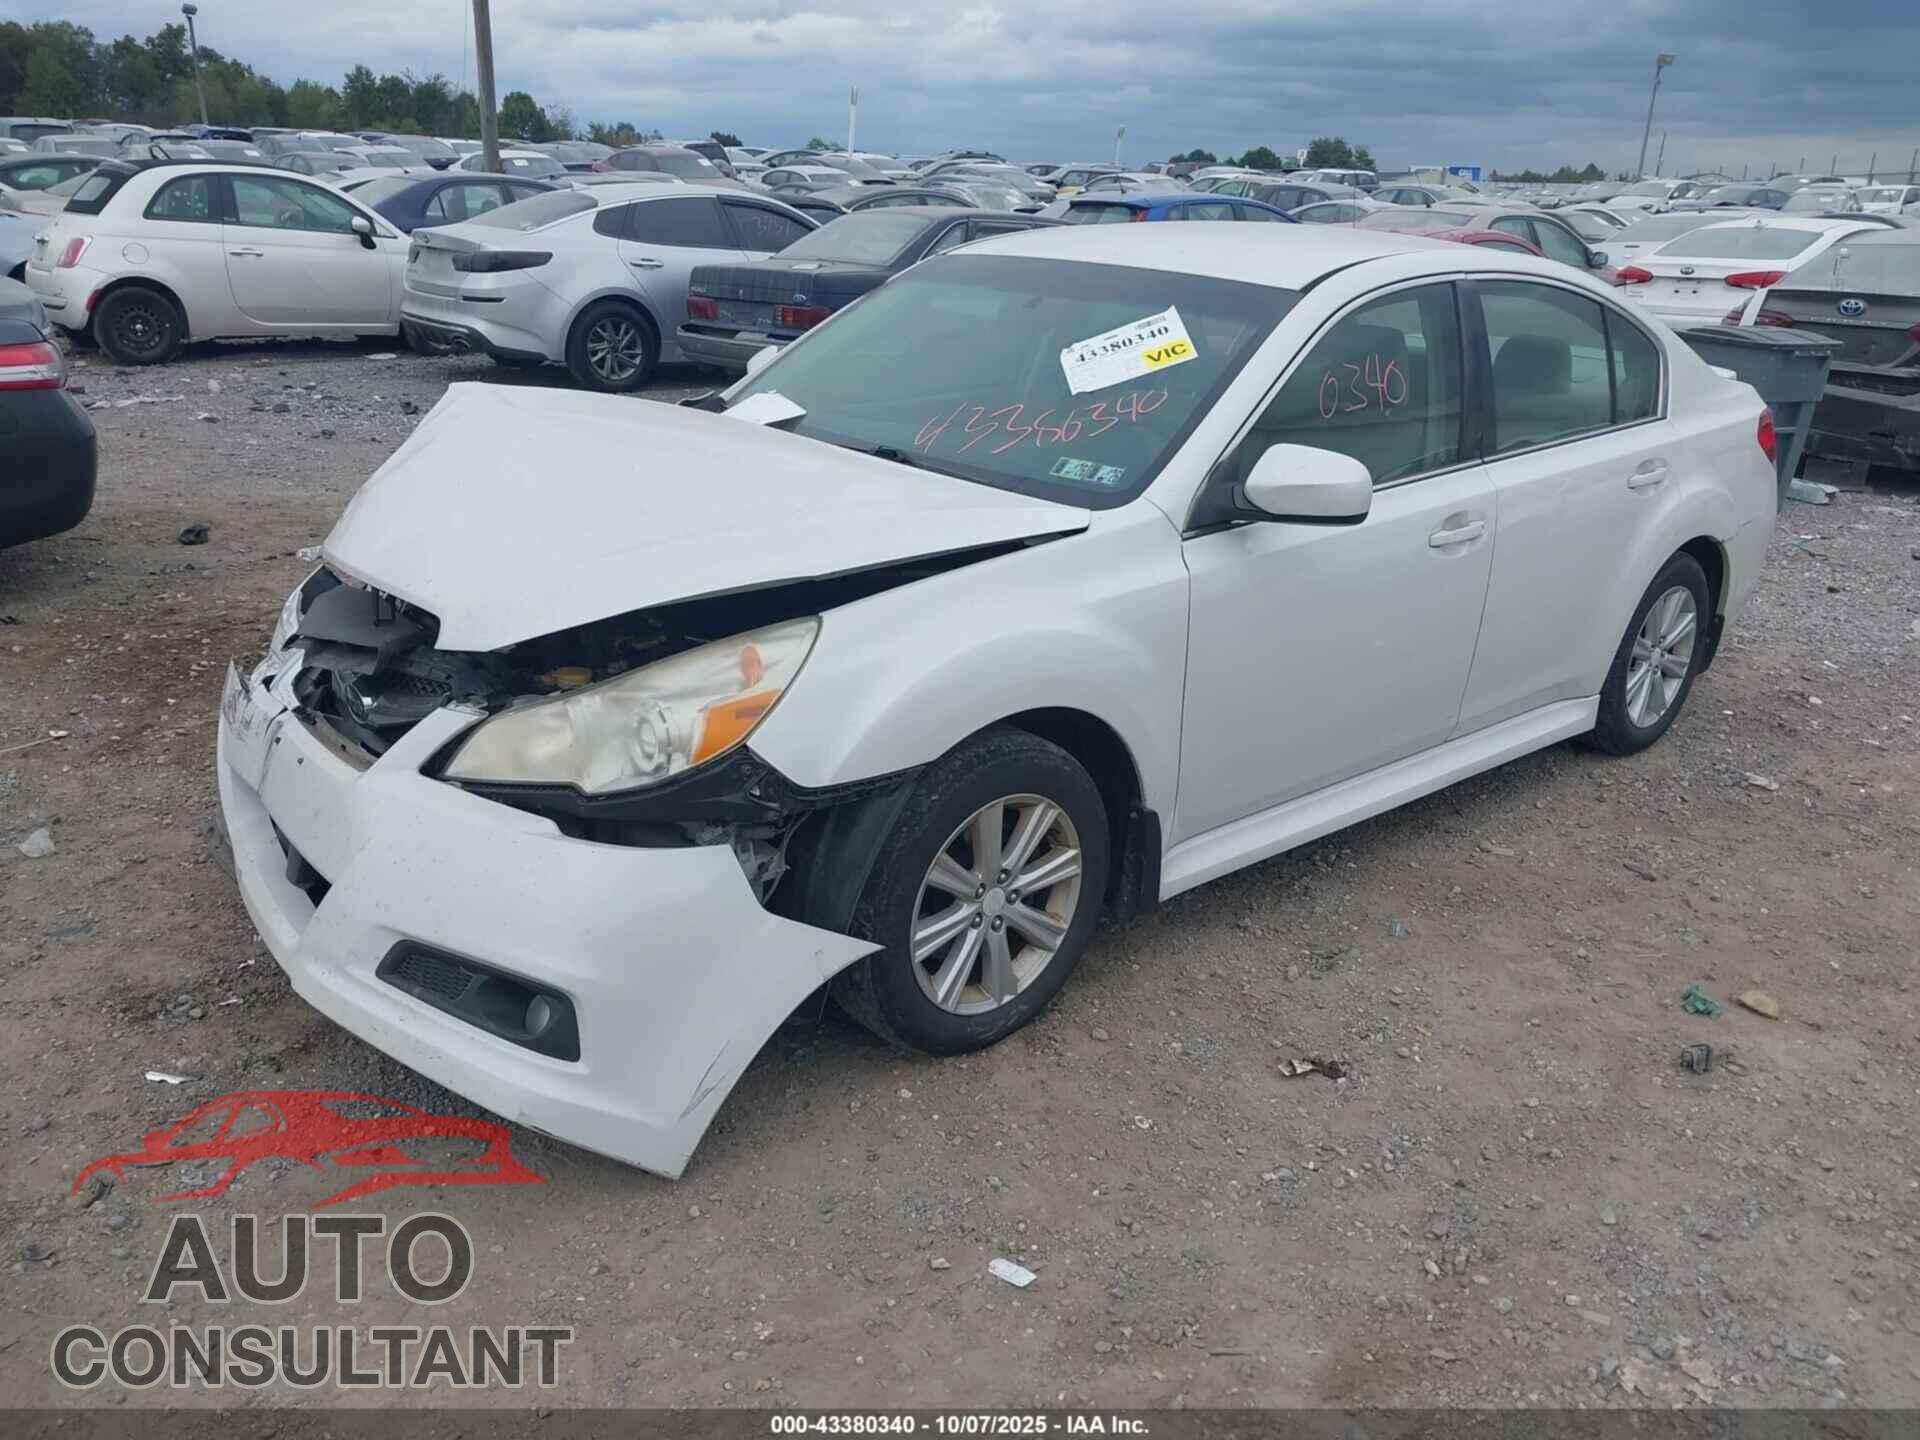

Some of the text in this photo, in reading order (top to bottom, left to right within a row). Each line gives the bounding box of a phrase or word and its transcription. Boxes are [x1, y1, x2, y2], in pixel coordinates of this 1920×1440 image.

[1075, 326, 1169, 363] 43380340
[1146, 343, 1187, 363] VIC
[1320, 353, 1406, 418] 0340
